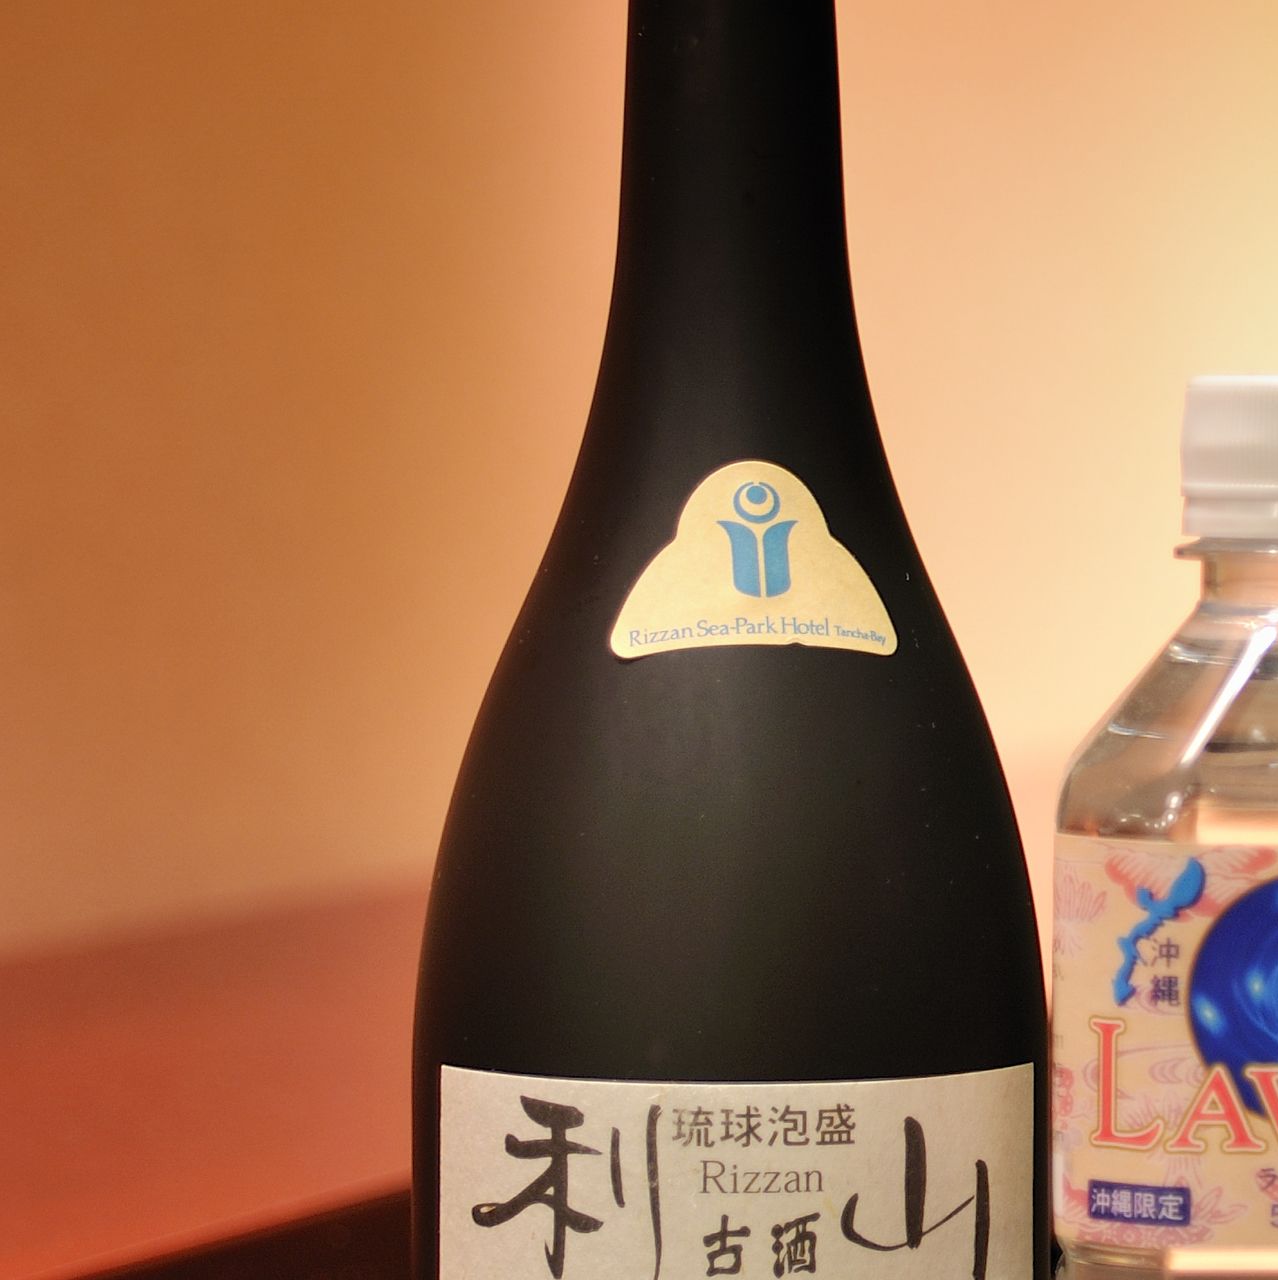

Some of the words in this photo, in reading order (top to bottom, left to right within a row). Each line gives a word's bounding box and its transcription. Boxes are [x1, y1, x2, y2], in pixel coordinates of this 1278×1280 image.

[628, 625, 694, 648] Rizzan
[695, 615, 776, 638] Sea-Park
[780, 615, 831, 637] Hotel
[1149, 938, 1181, 1008] 沖縄
[671, 1102, 858, 1149] 琉球泡盛
[699, 1159, 826, 1196] Rizzan
[1089, 1186, 1187, 1222] 沖縄限定
[701, 1211, 822, 1279] 古酒
